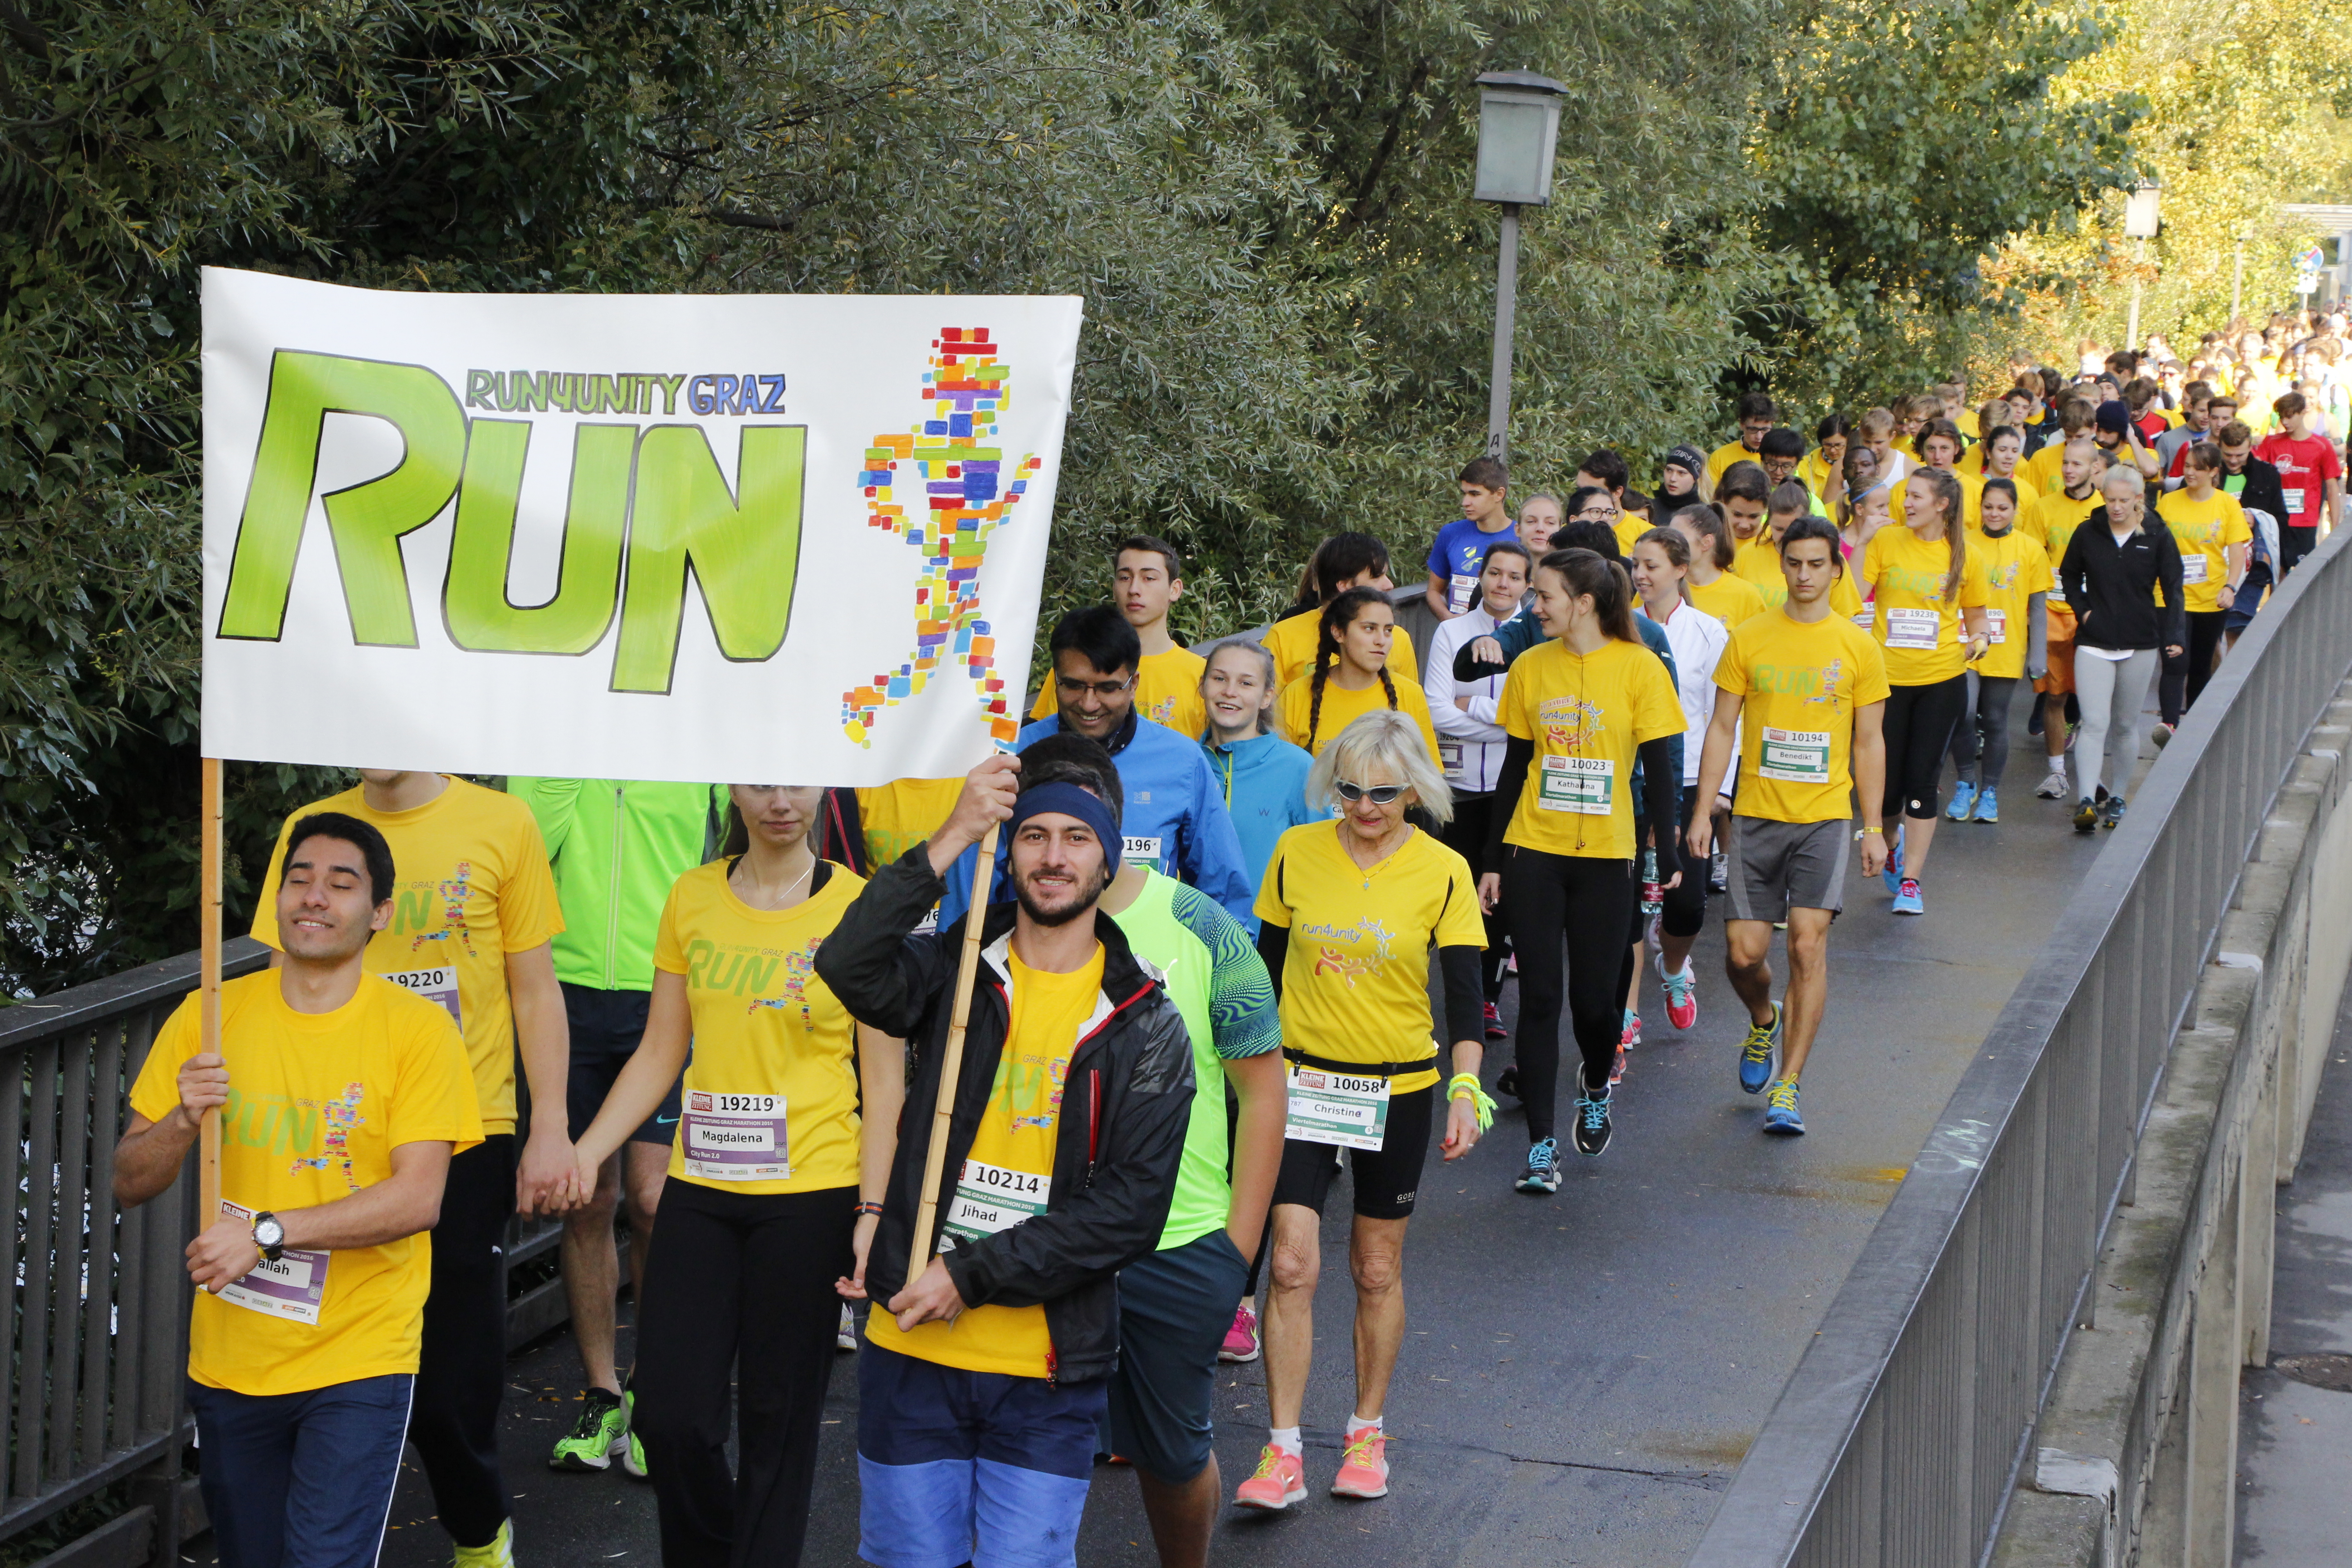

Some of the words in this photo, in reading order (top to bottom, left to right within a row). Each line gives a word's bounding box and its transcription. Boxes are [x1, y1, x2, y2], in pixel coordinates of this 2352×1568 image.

[465, 368, 688, 415] RUN4UNITY
[687, 373, 786, 416] GRAZ
[216, 347, 808, 696] RUN
[1886, 567, 1936, 594] RUN
[1910, 610, 1934, 618] 19238
[1754, 664, 1818, 696] RUN
[1548, 698, 1572, 708] JAHRE
[1540, 710, 1581, 722] run4unity
[1792, 733, 1823, 742] 10194
[1780, 752, 1813, 760] Benedikt
[1571, 759, 1605, 770] 10023
[1558, 780, 1595, 789] Kathaina
[1302, 923, 1362, 943] run4unity
[761, 948, 784, 957] GRAZ
[686, 939, 781, 996] RUN
[1023, 1054, 1047, 1065] GRAZ
[1301, 1073, 1325, 1082] KLEINE
[1333, 1077, 1380, 1093] 10058
[296, 1098, 321, 1109] GRAZ
[692, 1094, 711, 1103] KLEINE
[720, 1096, 774, 1112] 19219
[1314, 1103, 1362, 1118] Christine
[221, 1088, 318, 1156] RUN
[1292, 1117, 1338, 1129] Viertelmarathon
[702, 1131, 763, 1144] Magdalena
[691, 1150, 700, 1158] City
[975, 1166, 1039, 1193] 10214
[956, 1187, 971, 1197] TUNG
[971, 1192, 988, 1201] GRAZ
[987, 1196, 1021, 1209] MARATHON
[1397, 1191, 1415, 1200] GORE
[222, 1204, 250, 1221] KLEINE
[960, 1204, 998, 1223] Jihad
[255, 1259, 289, 1275] allah
